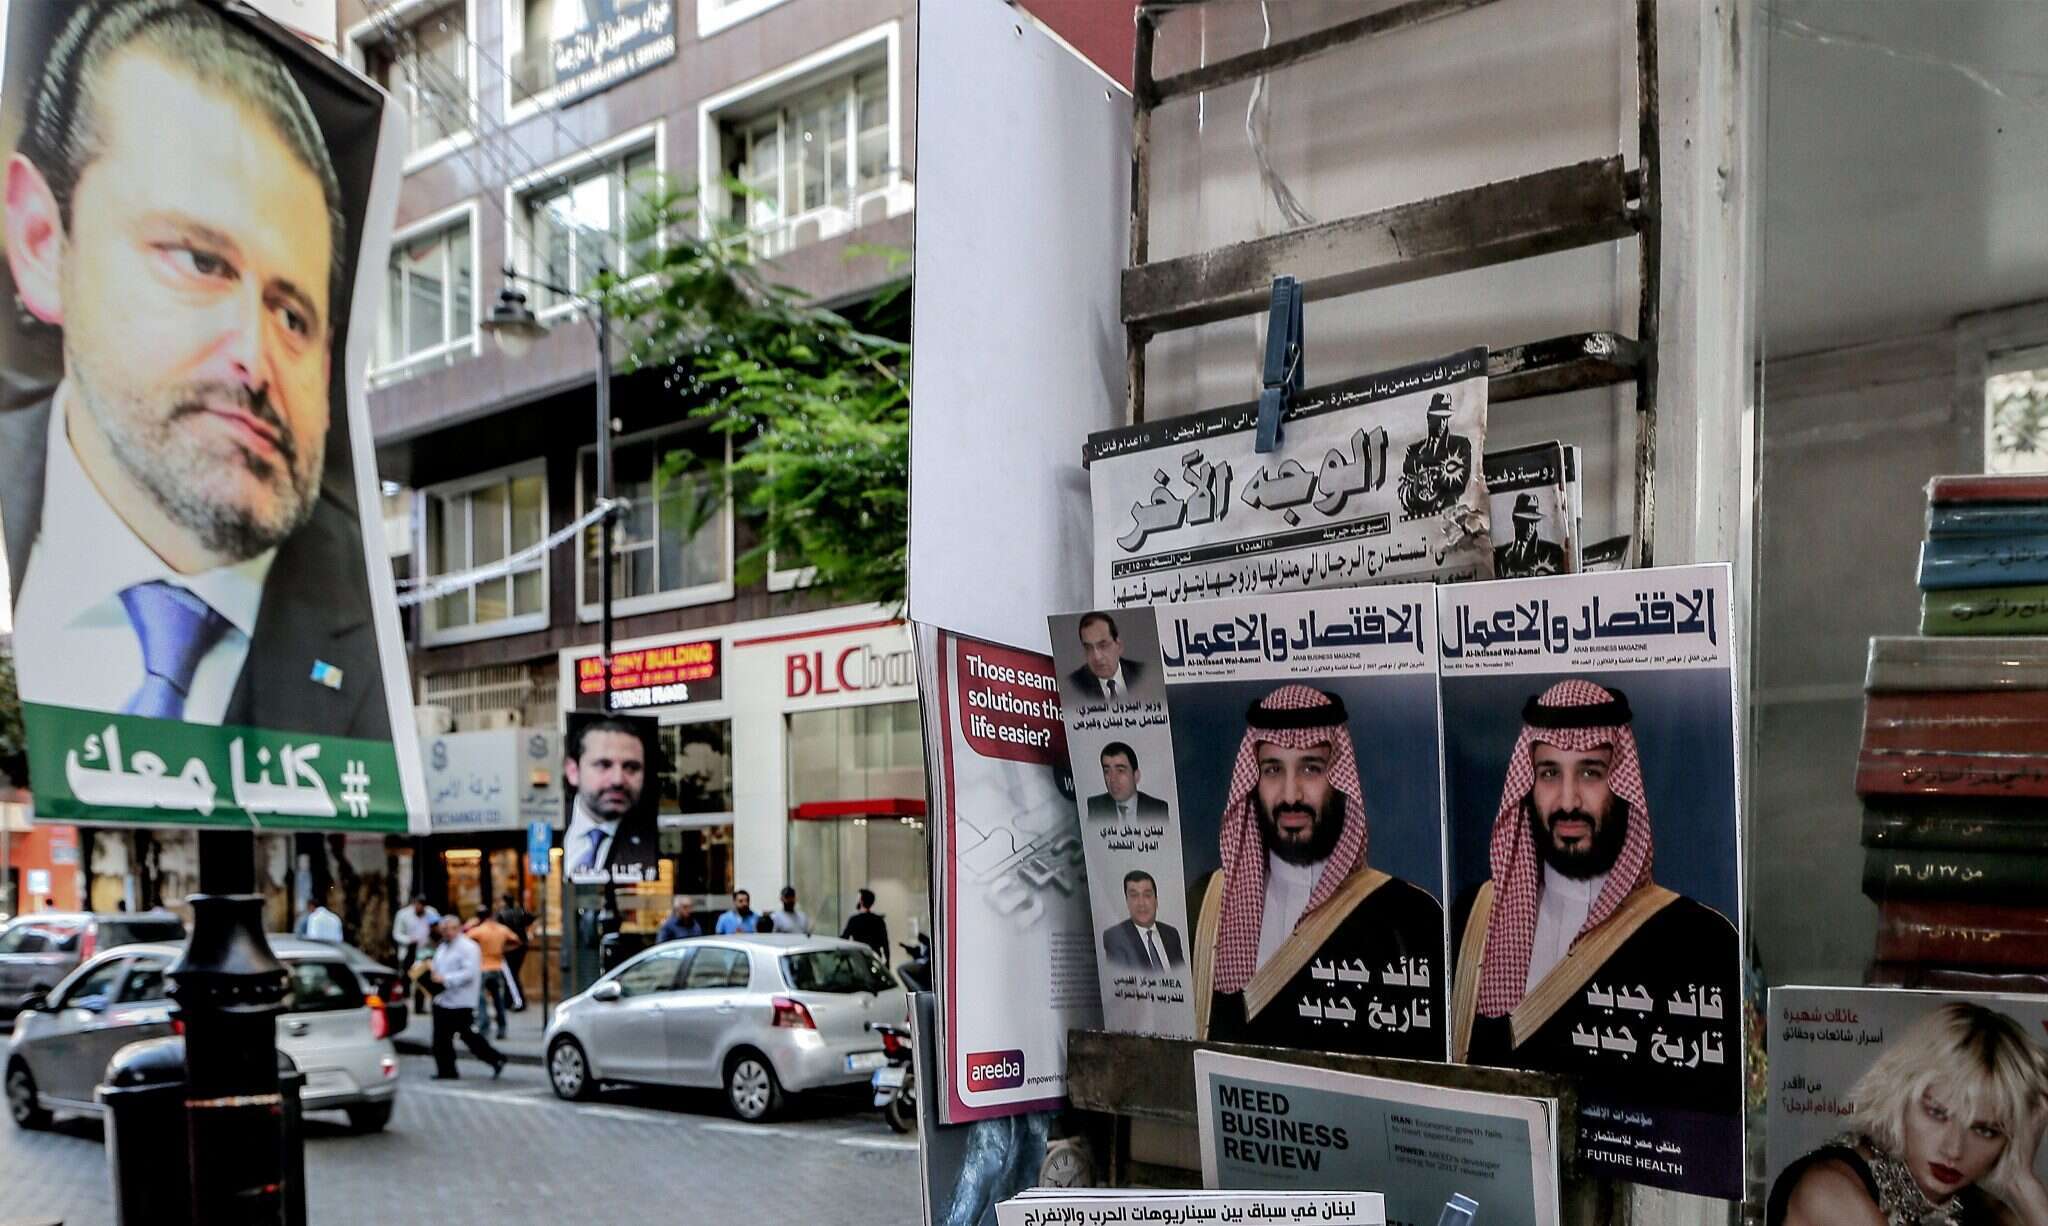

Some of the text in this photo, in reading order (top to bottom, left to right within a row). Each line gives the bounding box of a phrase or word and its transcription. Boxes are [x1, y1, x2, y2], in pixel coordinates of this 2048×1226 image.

[1241, 425, 1388, 527] الوجه
[1291, 603, 1425, 655] الاقتصاد
[1572, 588, 1717, 646] الاقتصاد
[786, 646, 861, 698] BLC
[966, 653, 1060, 692] Those seam
[968, 686, 1041, 718] solutions
[970, 713, 1051, 748] life easier?
[65, 723, 217, 817] معك
[1917, 864, 1935, 880] الى
[1961, 867, 1983, 881] من
[1311, 955, 1430, 990] قائد جديد
[1298, 995, 1431, 1033] تاريخ جديد
[1587, 982, 1723, 1020] قائد جديد
[1572, 1022, 1724, 1069] تاريخ جديد
[972, 1057, 1020, 1081] areeba
[1219, 1084, 1290, 1116] MEED
[1221, 1111, 1349, 1151] BUSINESS
[1223, 1137, 1321, 1172] REVIEW
[1587, 1149, 1683, 1176] FUTURE HEALTH
[1089, 1206, 1127, 1226] الحرب
[1131, 1204, 1217, 1225] سيناريوهات
[1221, 1204, 1243, 1223] بين
[1247, 1203, 1287, 1223] سباق
[1290, 1202, 1317, 1222] في
[1322, 1201, 1356, 1221] لبنان
